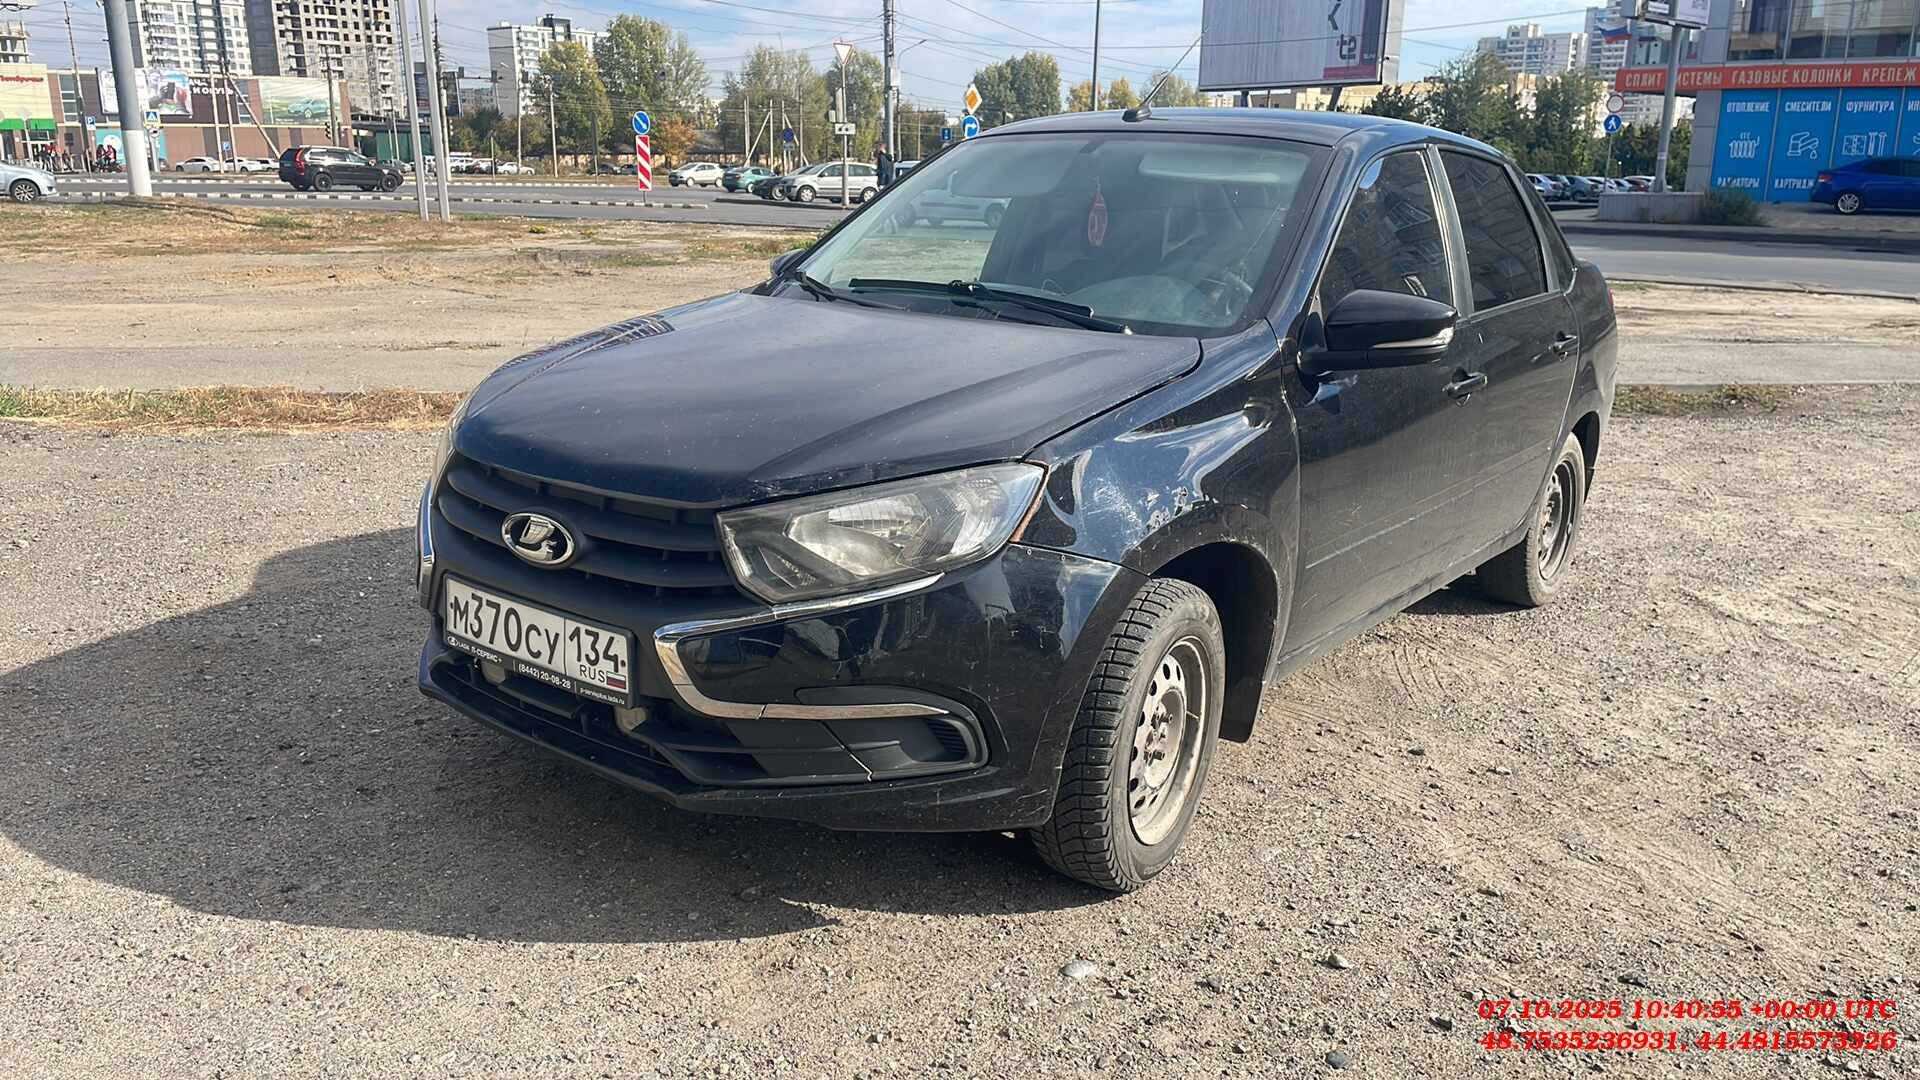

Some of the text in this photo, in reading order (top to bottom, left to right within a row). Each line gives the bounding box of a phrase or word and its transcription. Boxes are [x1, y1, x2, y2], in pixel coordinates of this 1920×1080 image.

[1625, 66, 1917, 87] СПЛИТ ИСТЕМЫ ГАЗОВЫЕ КОЛОНКИ КРЕПЕЖ
[1726, 101, 1770, 113] ОТОПЛЕНИЕ
[1785, 101, 1831, 113] СМЕСИТЕЛИ
[1846, 100, 1895, 113] ФУРНИТУРА
[569, 626, 619, 674] 134
[580, 664, 606, 684] RUS
